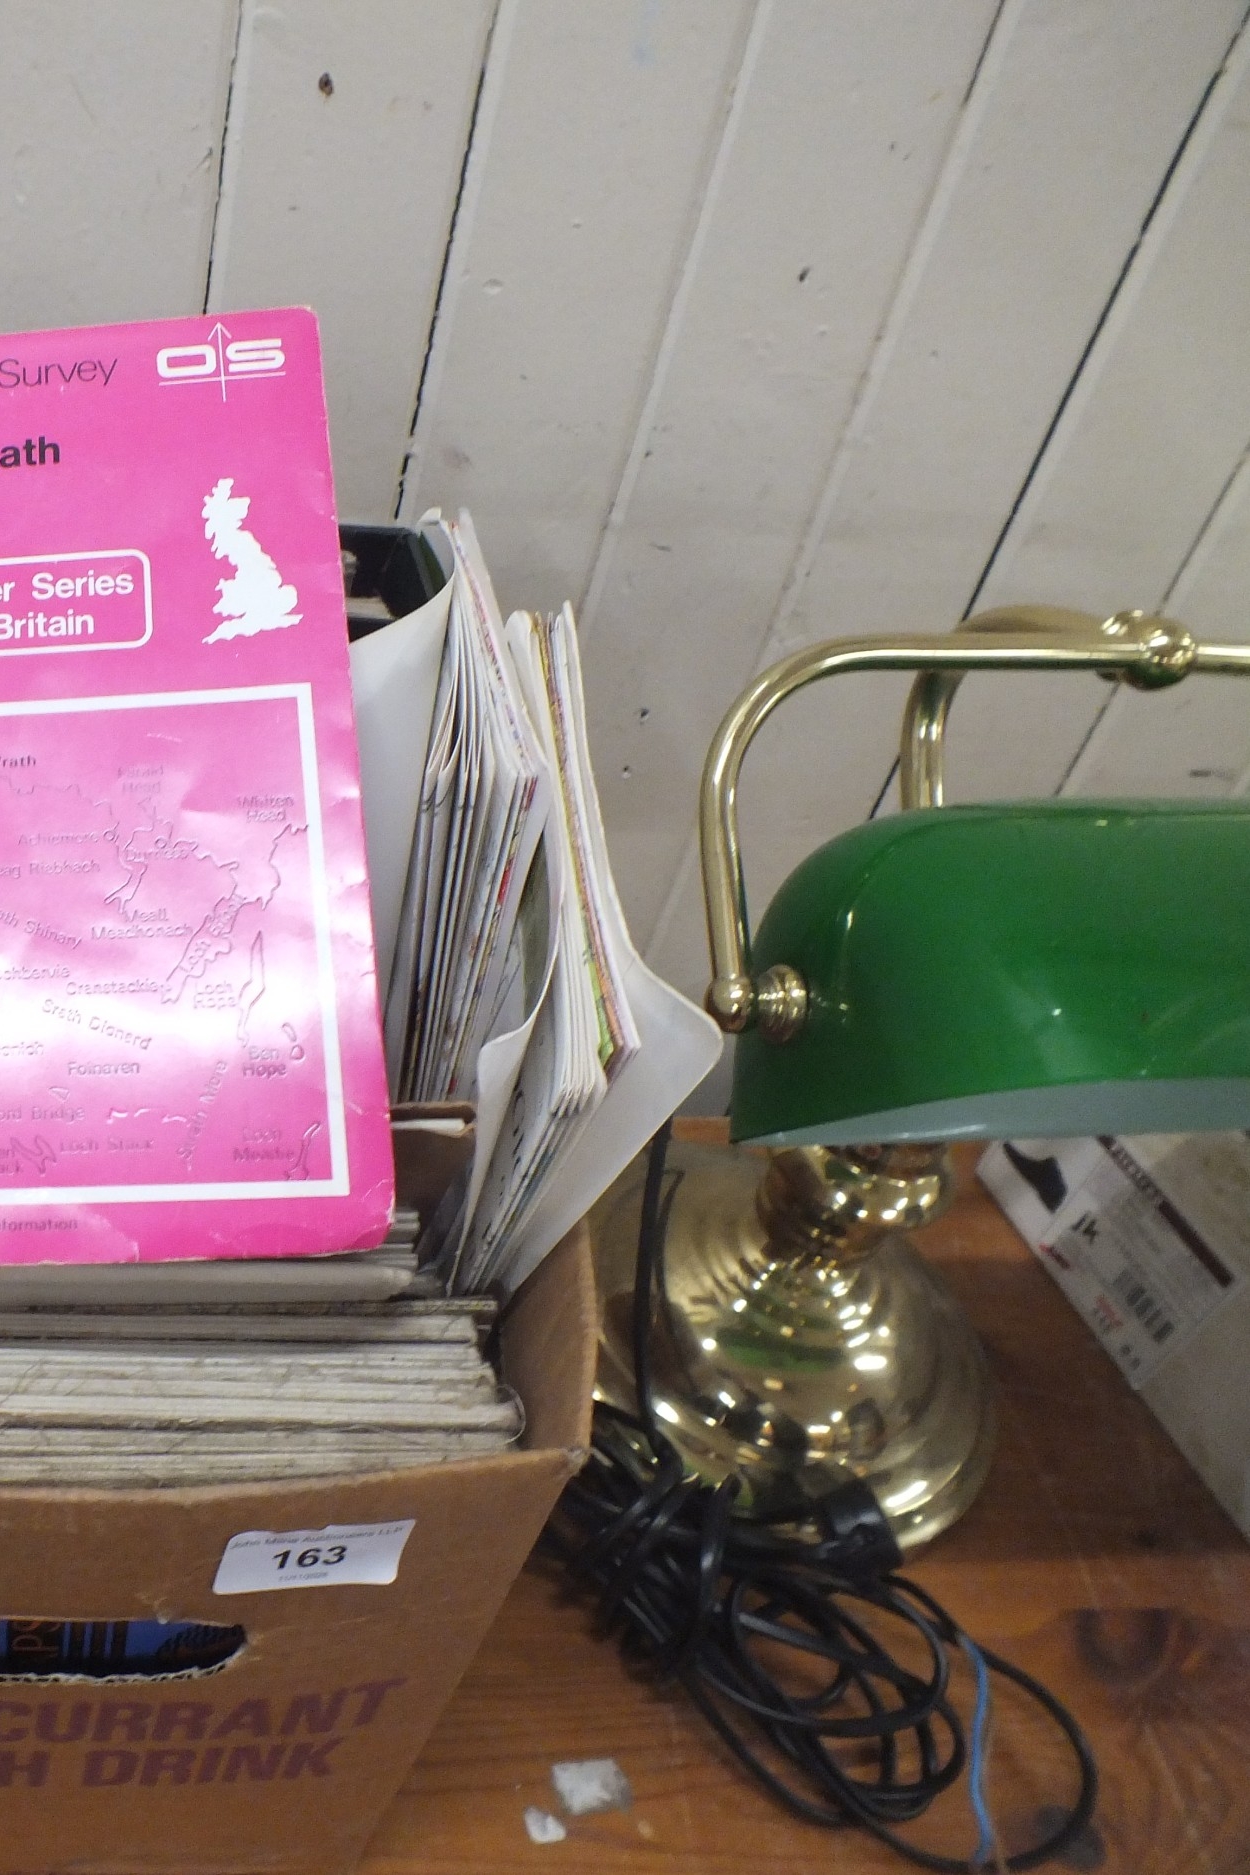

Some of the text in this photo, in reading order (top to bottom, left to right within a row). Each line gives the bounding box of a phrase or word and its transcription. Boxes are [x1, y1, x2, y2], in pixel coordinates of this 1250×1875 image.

[156, 339, 286, 379] OS
[31, 569, 134, 600] Series
[29, 858, 101, 875] Riabhach
[124, 907, 169, 923] Meall
[24, 918, 83, 950] Shinary
[178, 939, 211, 973] Loch
[66, 978, 159, 996] Cranstackie
[195, 981, 233, 995] Loch
[250, 1046, 280, 1061] Ben
[66, 1061, 141, 1076] Foinaven
[242, 1062, 288, 1080] Hope
[31, 1105, 86, 1124] Bridge
[271, 1544, 349, 1570] 163
[81, 1736, 346, 1787] DRINK
